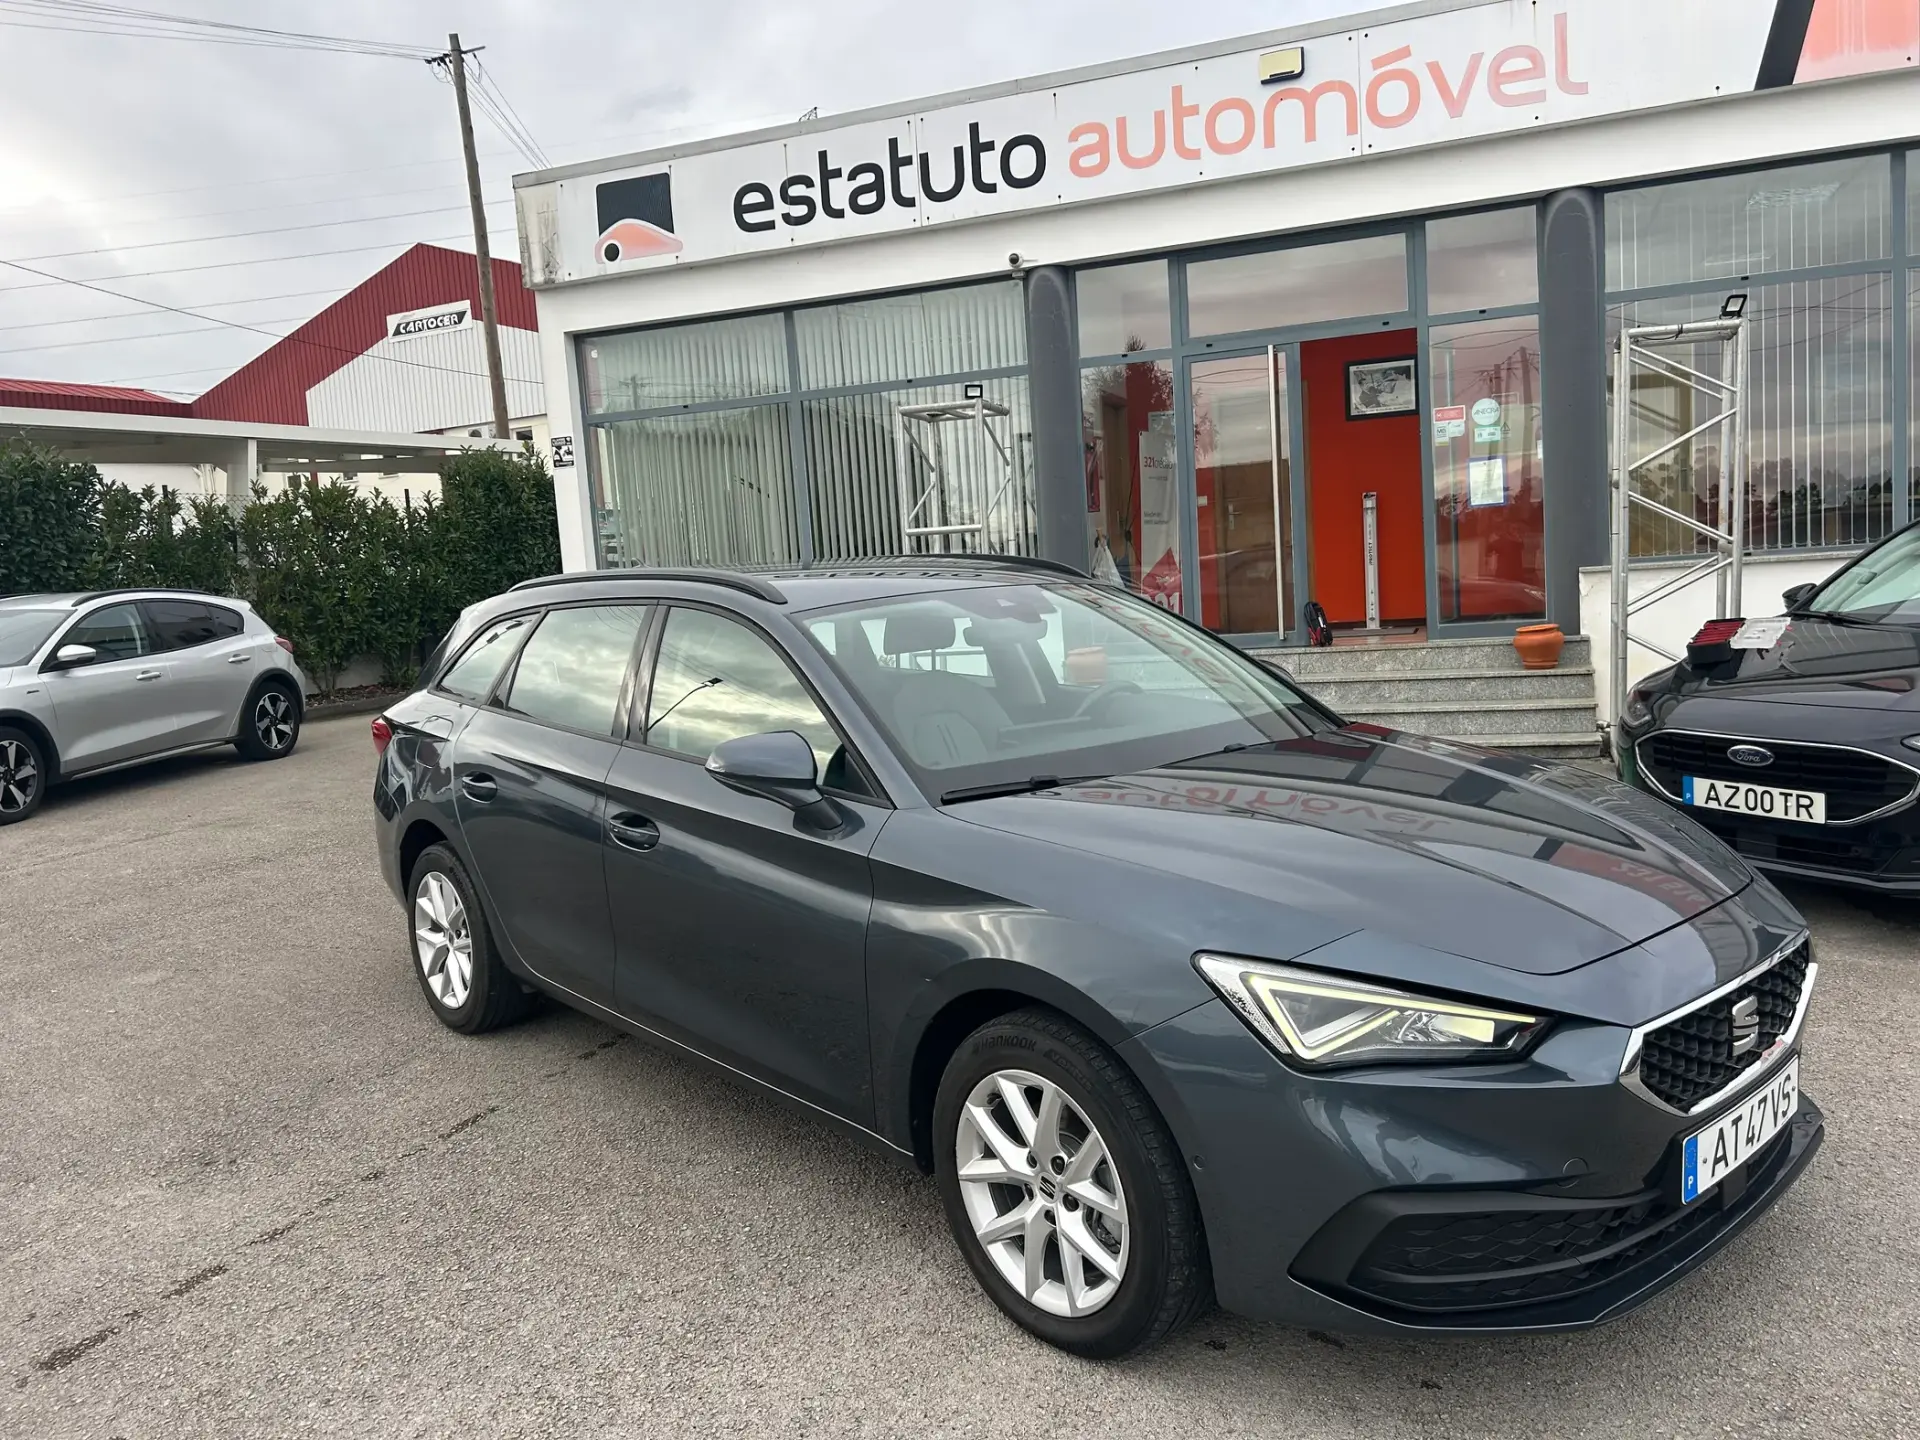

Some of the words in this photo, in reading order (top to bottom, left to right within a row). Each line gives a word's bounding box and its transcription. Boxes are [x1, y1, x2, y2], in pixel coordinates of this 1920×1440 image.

[733, 122, 1047, 233] estatuto
[1067, 12, 1589, 178] automóvel
[399, 313, 459, 334] CARTOCER
[1473, 406, 1500, 416] ANECRA
[1736, 750, 1761, 762] Ford
[1687, 1175, 1694, 1190] P
